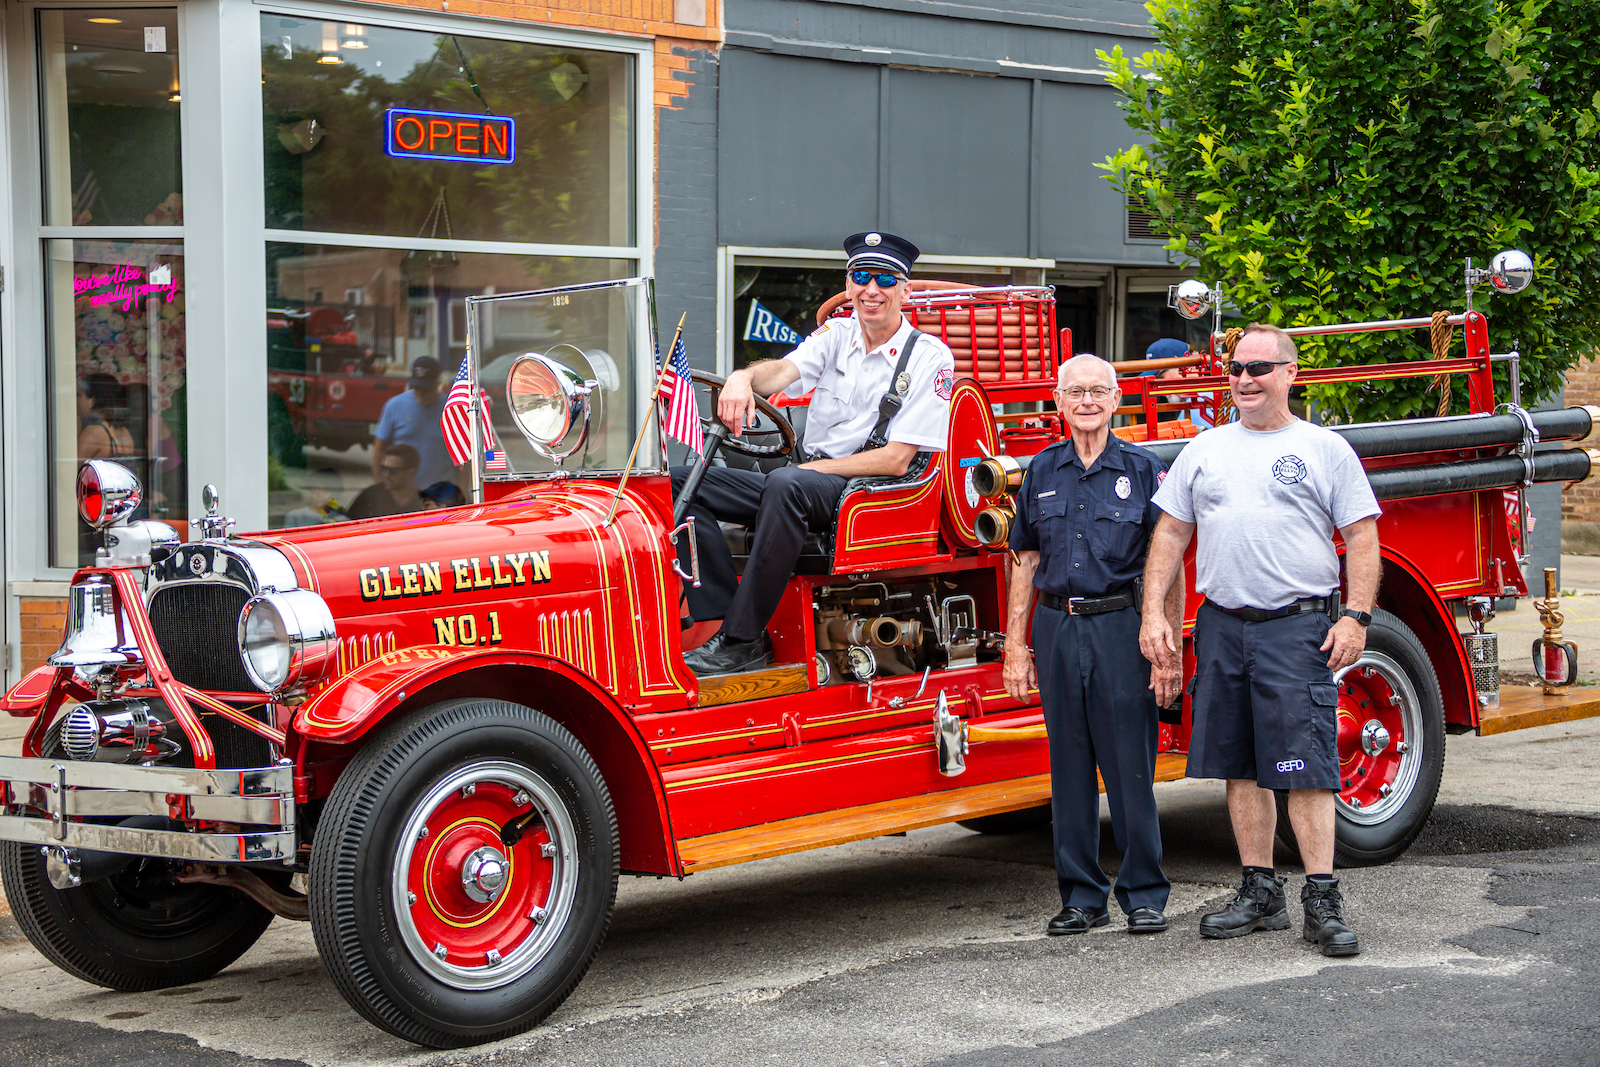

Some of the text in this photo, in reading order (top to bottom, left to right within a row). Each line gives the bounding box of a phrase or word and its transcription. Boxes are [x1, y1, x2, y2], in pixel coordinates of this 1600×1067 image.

[395, 117, 507, 155] OPEN
[112, 262, 142, 284] like
[90, 283, 133, 312] really
[359, 550, 551, 602] GLEN ELLYN
[1276, 759, 1305, 773] GEFD
